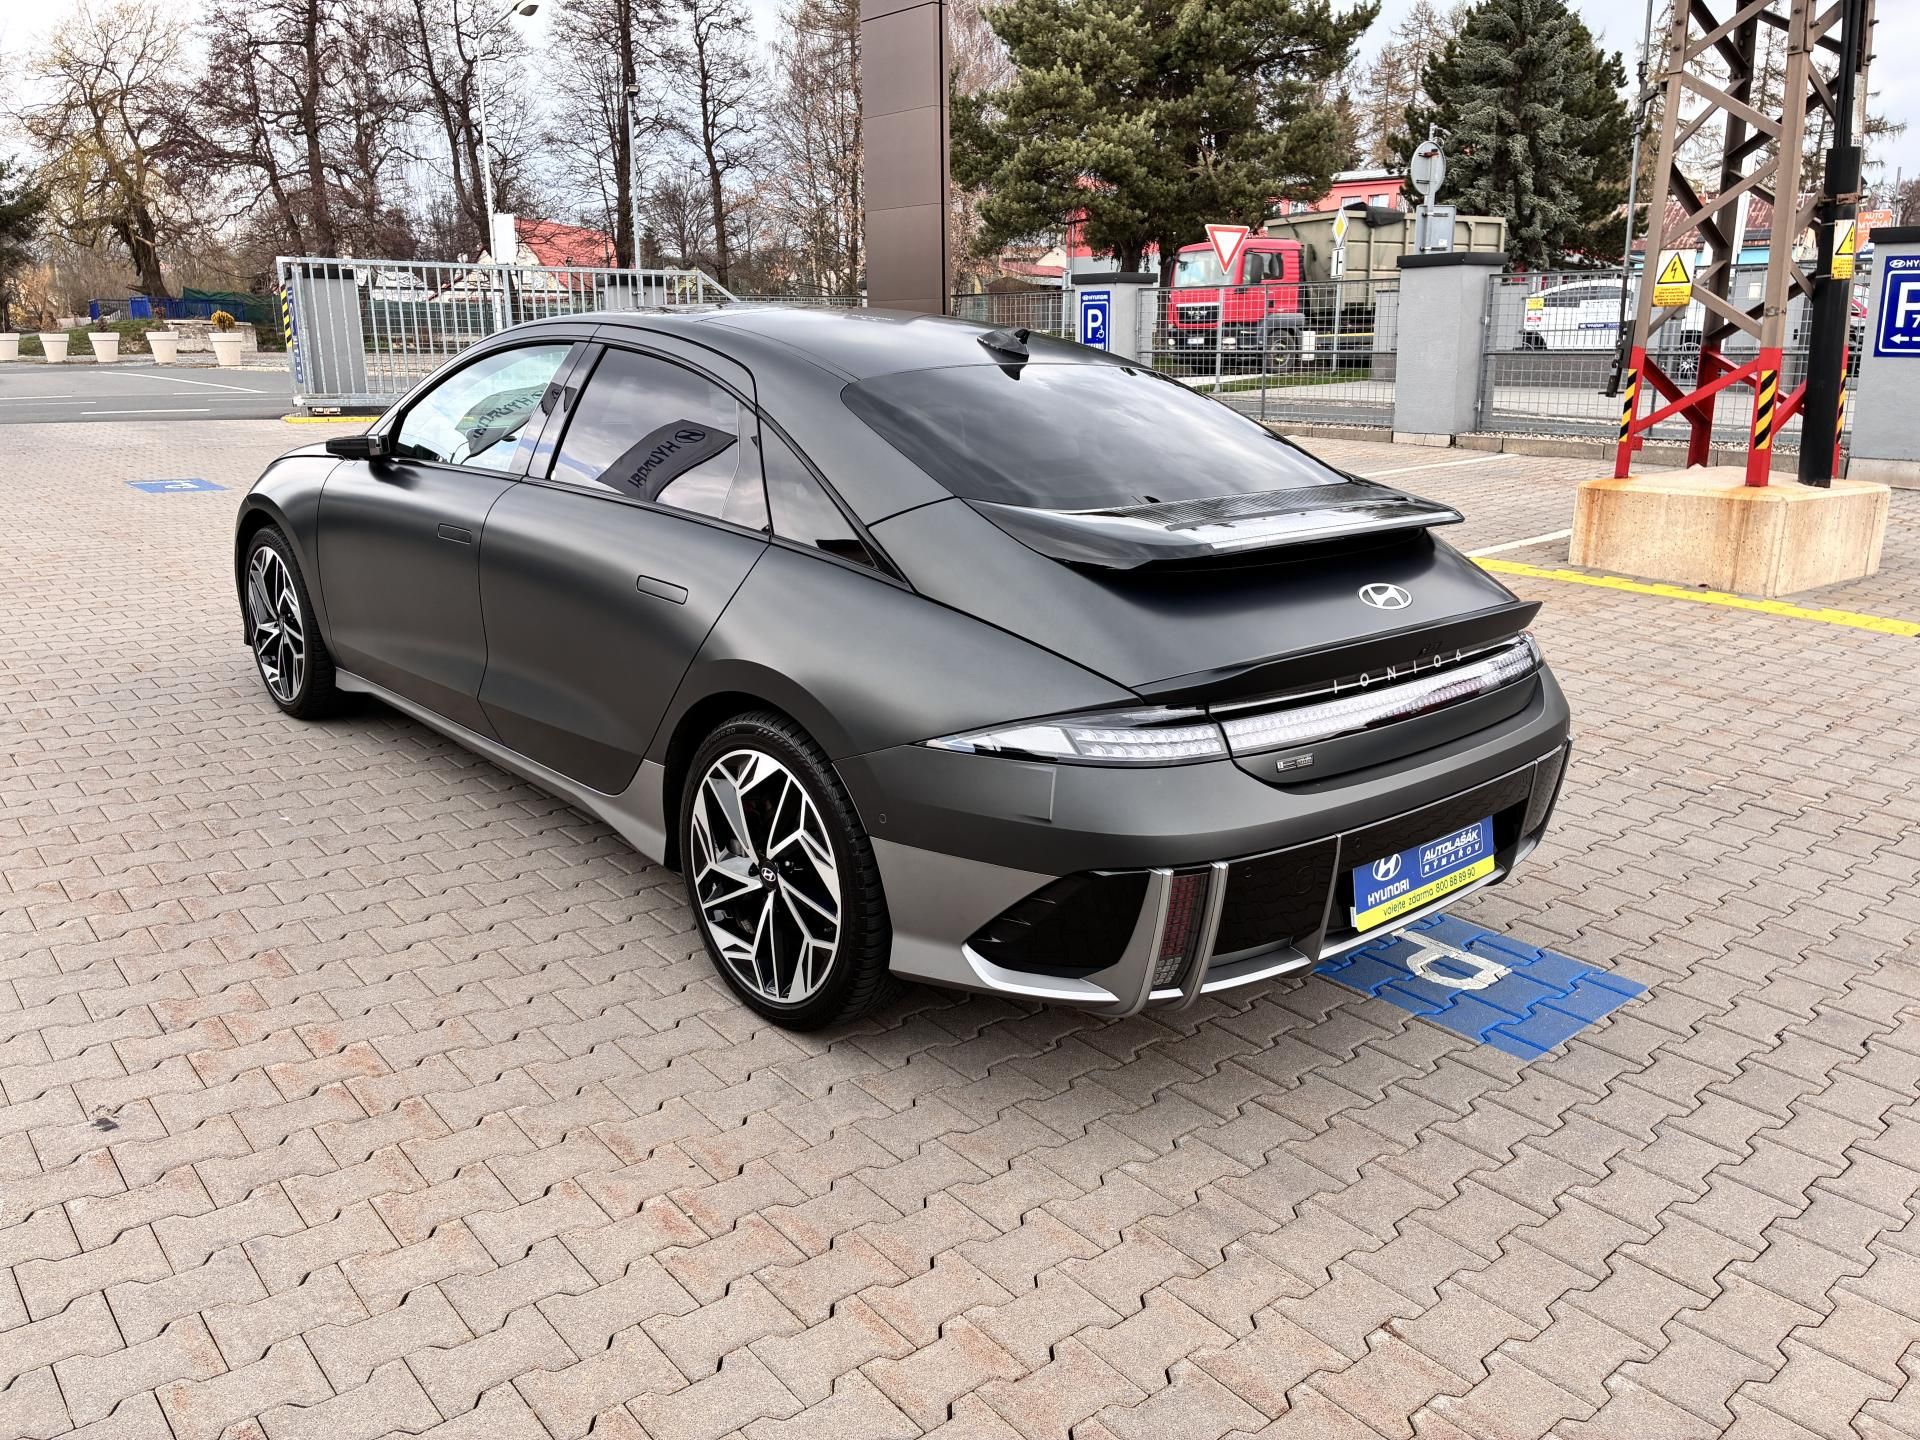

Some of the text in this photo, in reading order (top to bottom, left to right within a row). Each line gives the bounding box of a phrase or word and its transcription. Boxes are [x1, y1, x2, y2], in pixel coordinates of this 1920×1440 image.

[1864, 212, 1884, 220] AUTO
[1905, 259, 1920, 268] HY
[1087, 308, 1103, 339] P
[1423, 828, 1479, 862] AUTOLAŠÁK
[1424, 842, 1480, 873] RÝMAŘOV
[1367, 878, 1410, 906] HYUNDAI
[1383, 900, 1406, 916] volejte
[1408, 887, 1434, 906] zdarma
[1435, 880, 1449, 893] 800
[1467, 866, 1476, 879] 90
